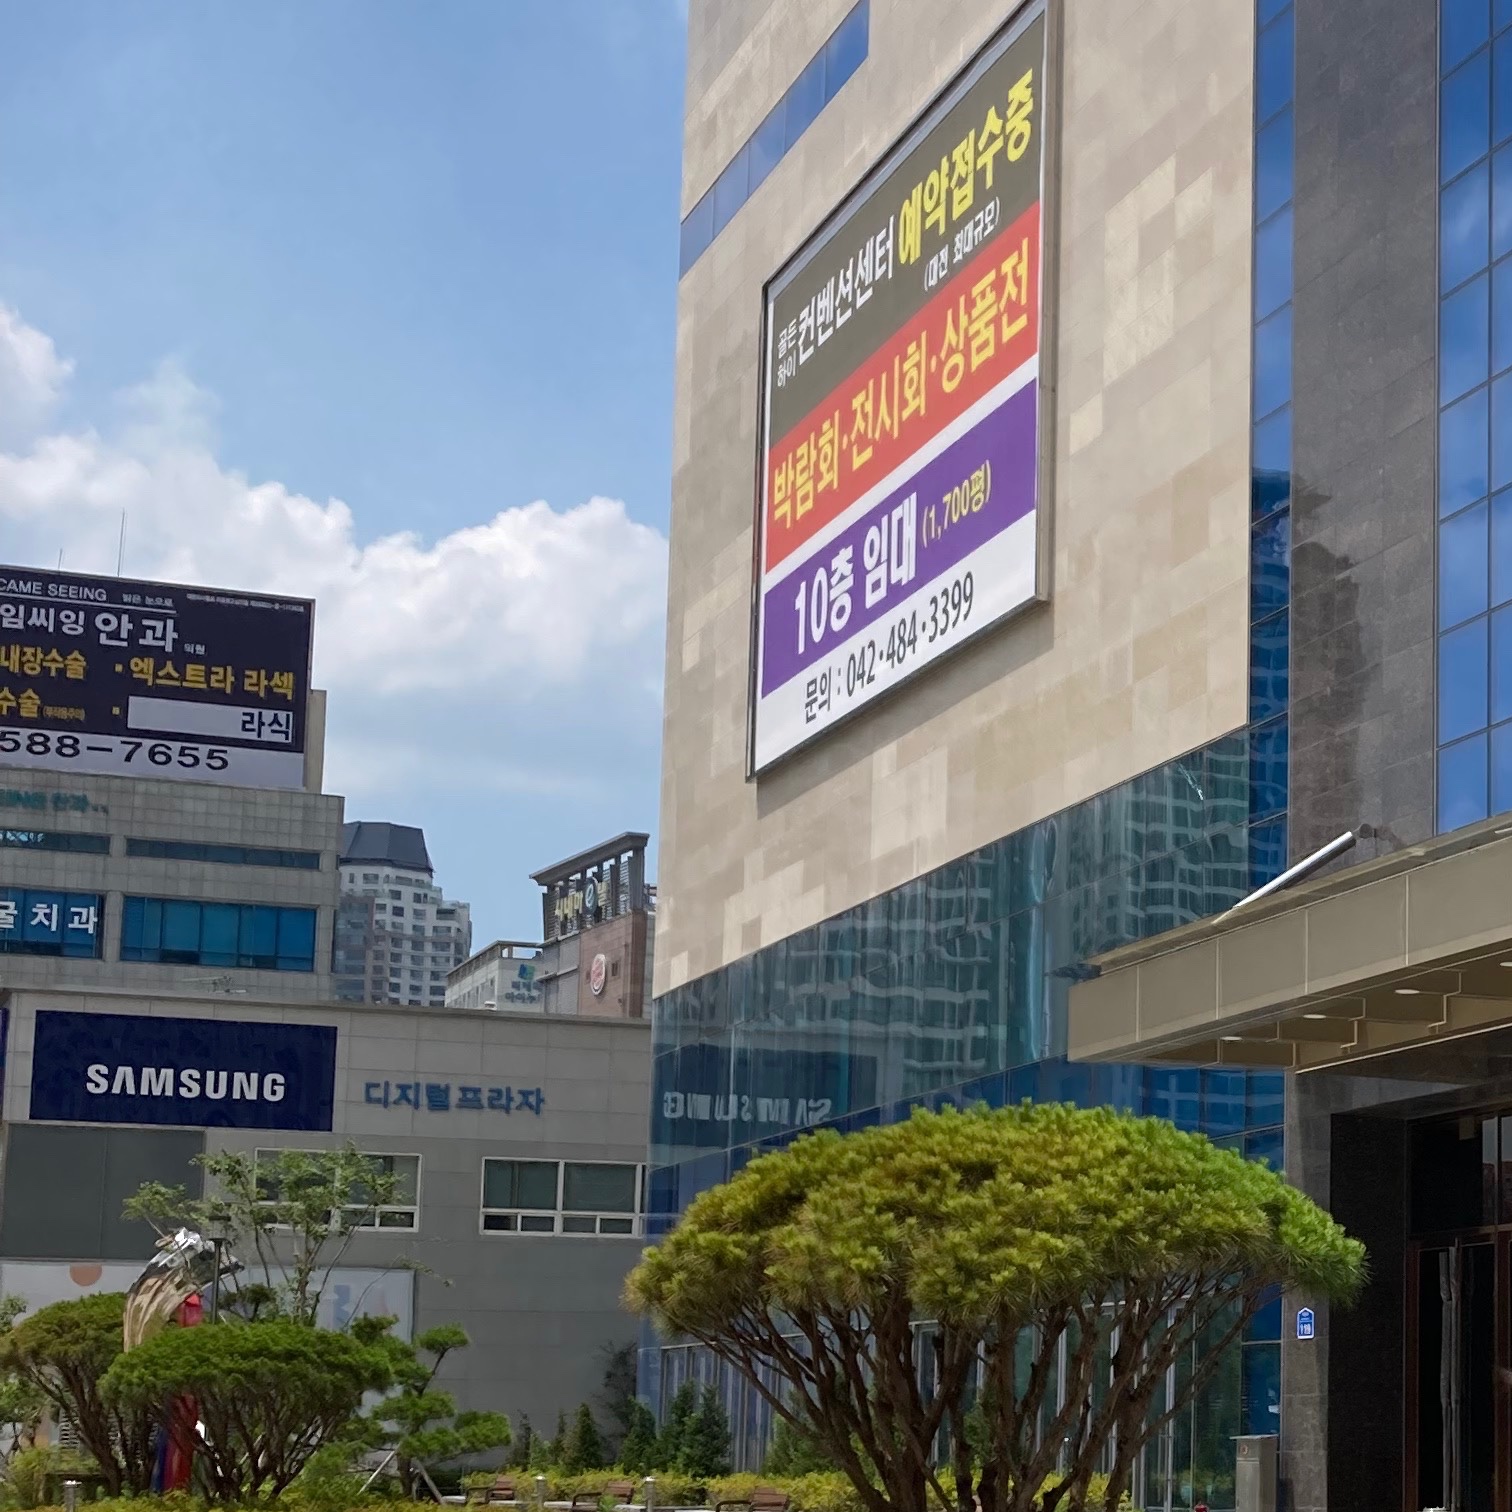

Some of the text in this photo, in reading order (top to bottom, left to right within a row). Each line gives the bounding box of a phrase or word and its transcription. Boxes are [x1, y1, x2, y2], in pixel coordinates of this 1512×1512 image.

[797, 68, 1034, 366] 컨벤션센터 예약접수중
[953, 196, 1000, 264] 최대규모)
[795, 458, 992, 656] 10층 임대 (1,700평)
[47, 583, 107, 601] SEEING
[94, 611, 179, 653] 안과
[129, 655, 236, 695] 엑스트라
[243, 668, 295, 701] 라섹
[805, 665, 832, 724] 문의
[240, 711, 292, 742] 라식
[85, 1063, 287, 1103] SAMSUNG
